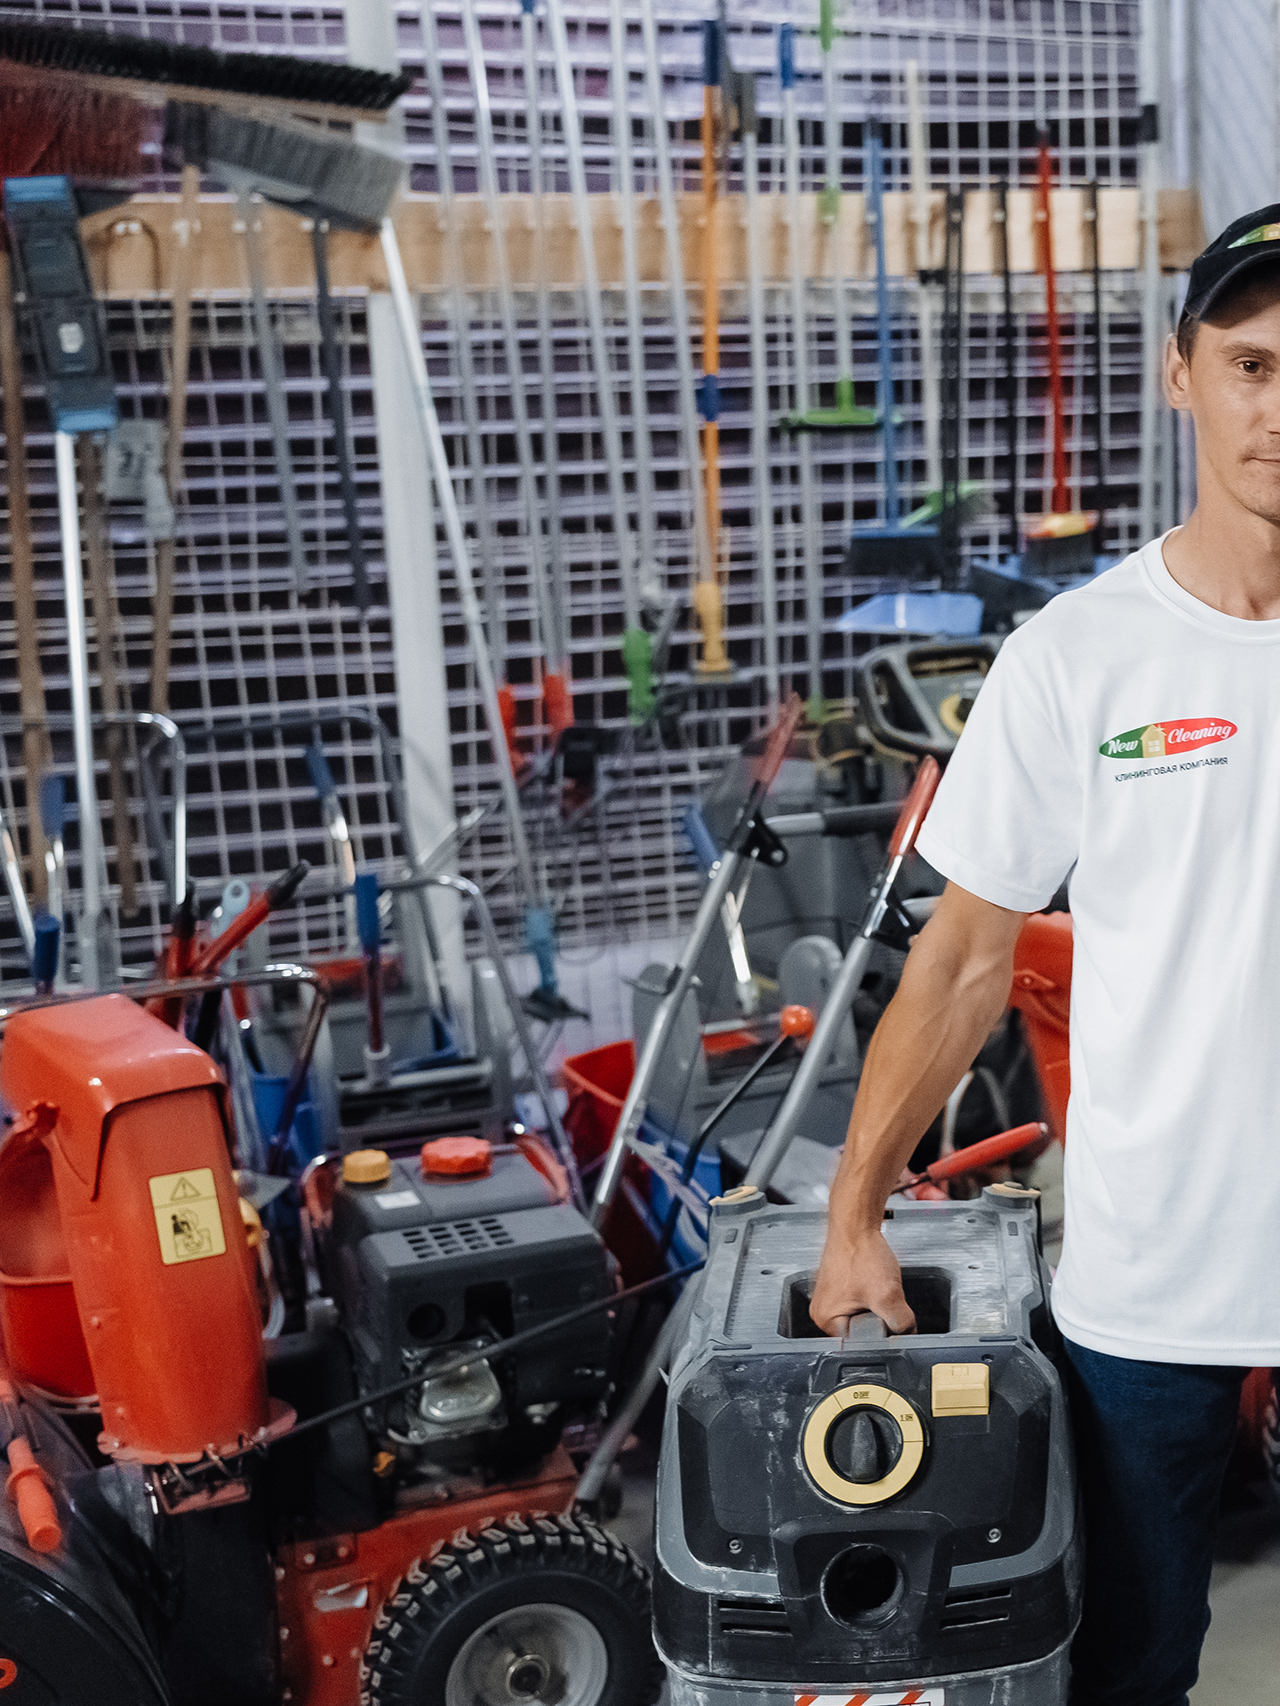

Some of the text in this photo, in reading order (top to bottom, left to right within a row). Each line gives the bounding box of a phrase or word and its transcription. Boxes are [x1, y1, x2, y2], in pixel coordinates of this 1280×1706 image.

[1107, 722, 1232, 755] New Cleaning
[1115, 757, 1229, 782] КЛИНИНГОВАЯ КОМПАНИЯ
